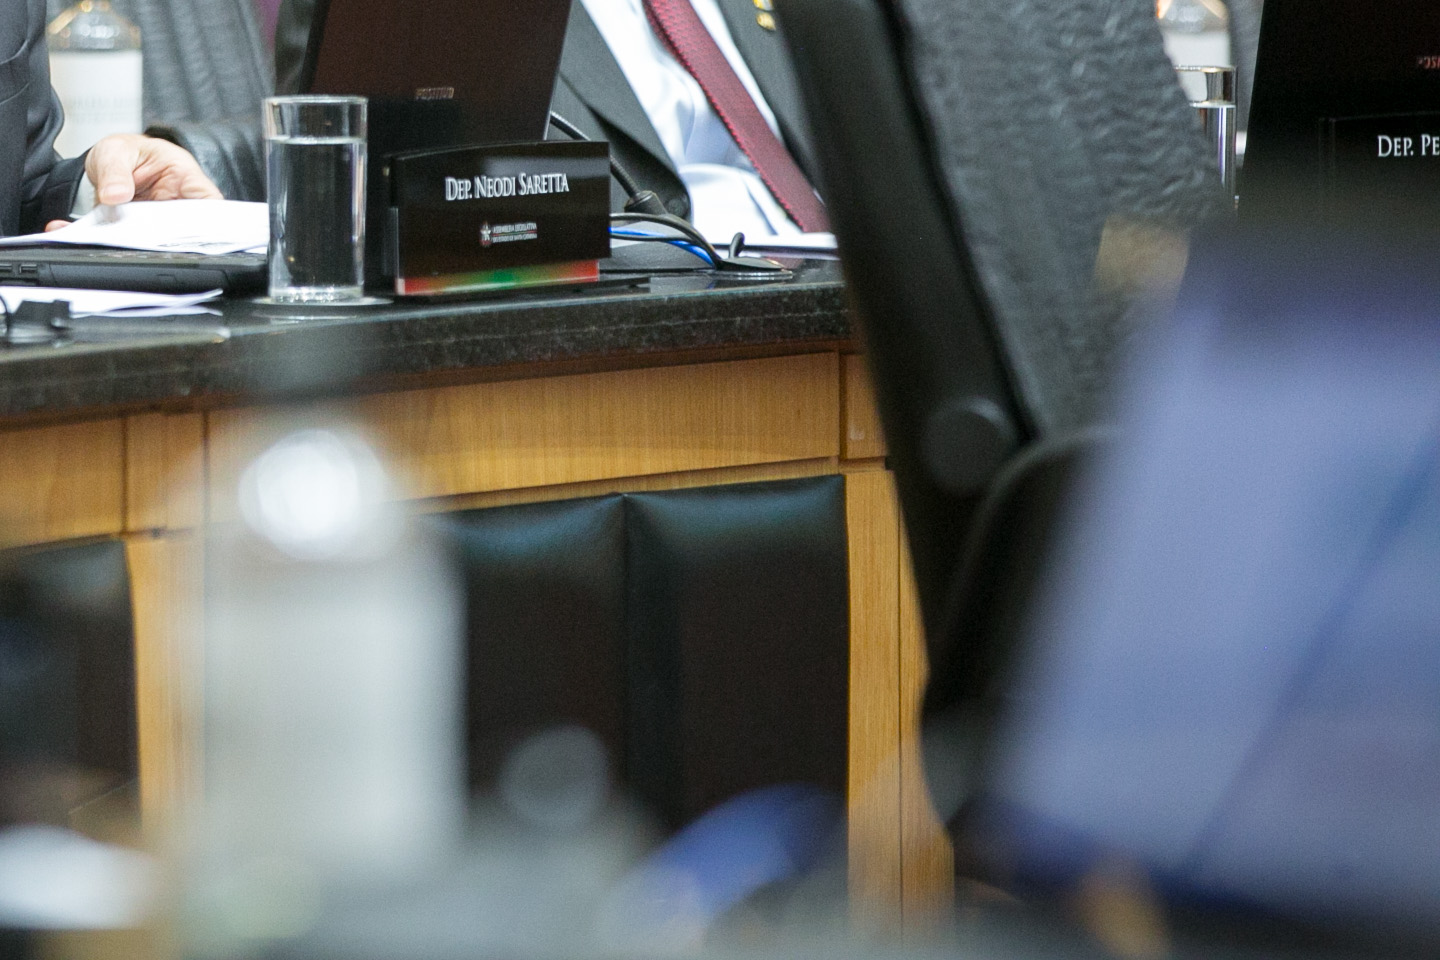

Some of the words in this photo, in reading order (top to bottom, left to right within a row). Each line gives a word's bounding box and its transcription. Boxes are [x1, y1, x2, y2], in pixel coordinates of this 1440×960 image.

[1377, 135, 1414, 157] DEP.
[445, 176, 473, 201] DEP.
[474, 175, 516, 199] NEODI
[519, 173, 569, 195] SARETTA
